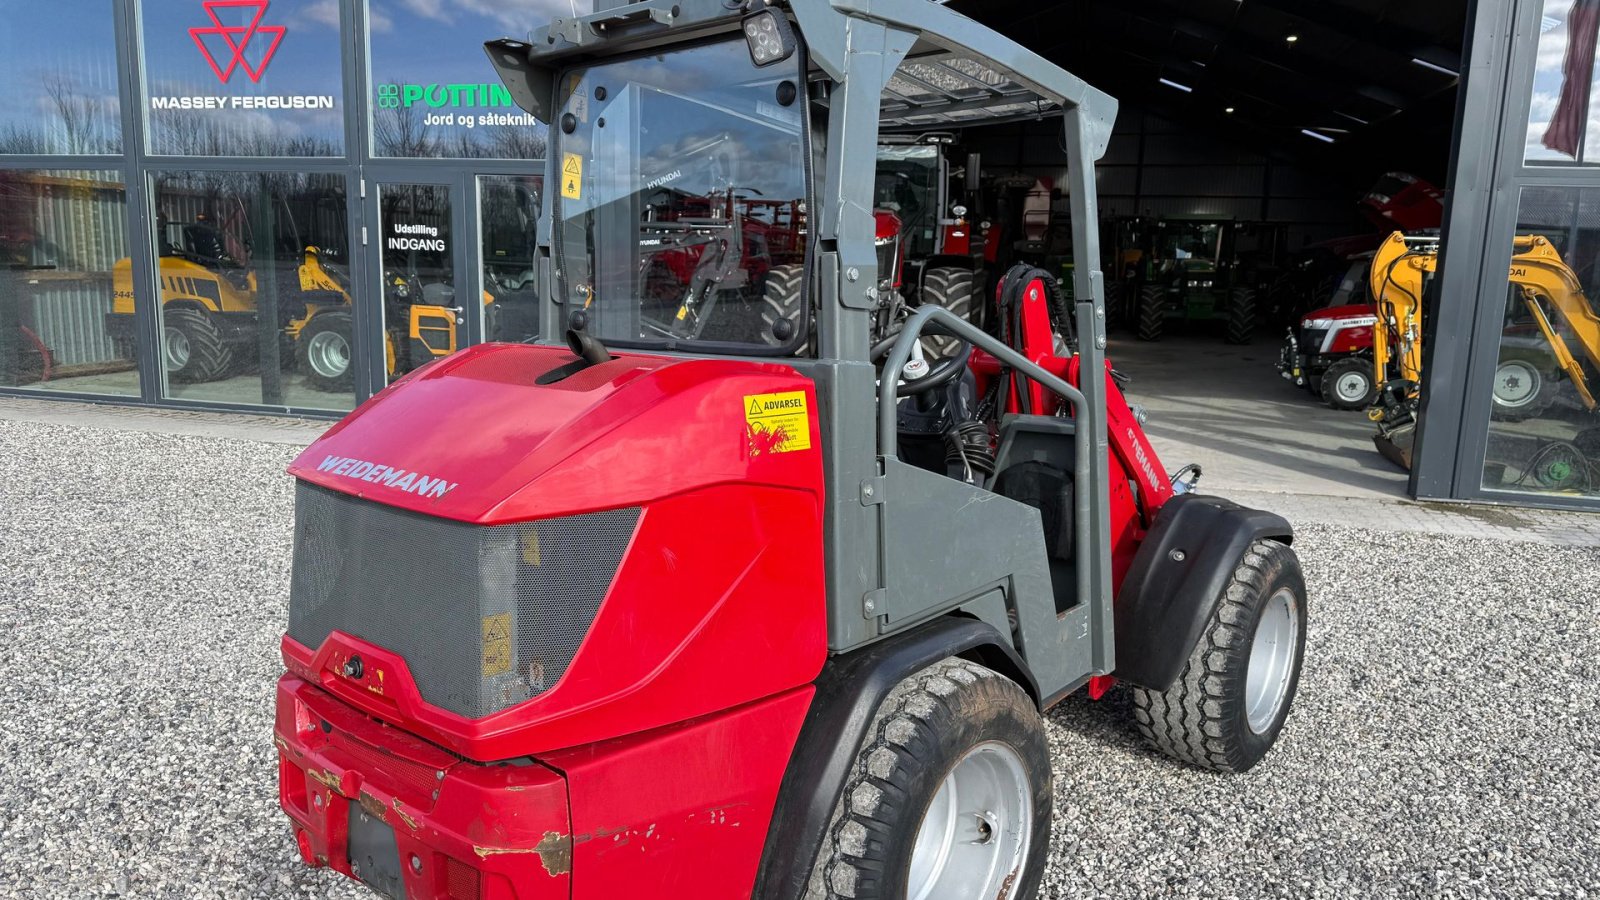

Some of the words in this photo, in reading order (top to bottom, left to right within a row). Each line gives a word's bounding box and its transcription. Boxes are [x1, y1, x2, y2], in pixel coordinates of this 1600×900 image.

[152, 96, 228, 109] MASSEY
[232, 95, 333, 109] FERGUSON
[424, 113, 454, 126] Jord
[457, 115, 475, 129] og
[478, 112, 536, 126] såteknik
[647, 169, 682, 190] HYUNDAI
[394, 223, 438, 237] Udstilling
[388, 237, 446, 252] INDGANG
[764, 398, 803, 411] ADVARSEL
[316, 454, 459, 498] WEIDEMANN
